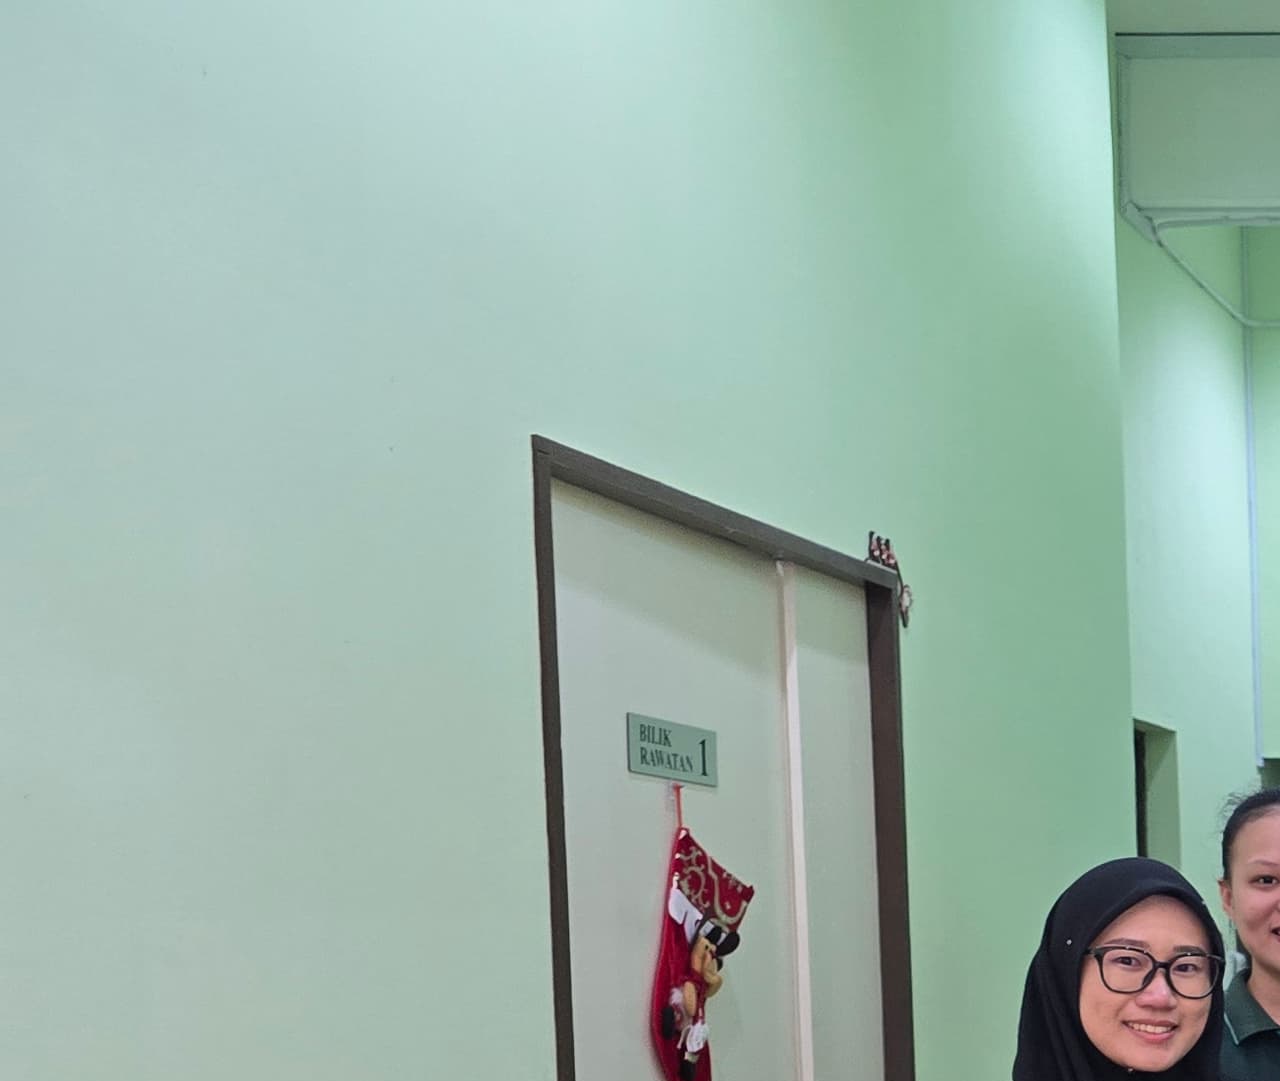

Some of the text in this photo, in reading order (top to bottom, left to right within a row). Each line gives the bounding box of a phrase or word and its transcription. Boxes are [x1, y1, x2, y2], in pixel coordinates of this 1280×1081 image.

[639, 723, 672, 748] BILIK
[640, 746, 694, 773] RAWATAN
[698, 738, 708, 776] 1
